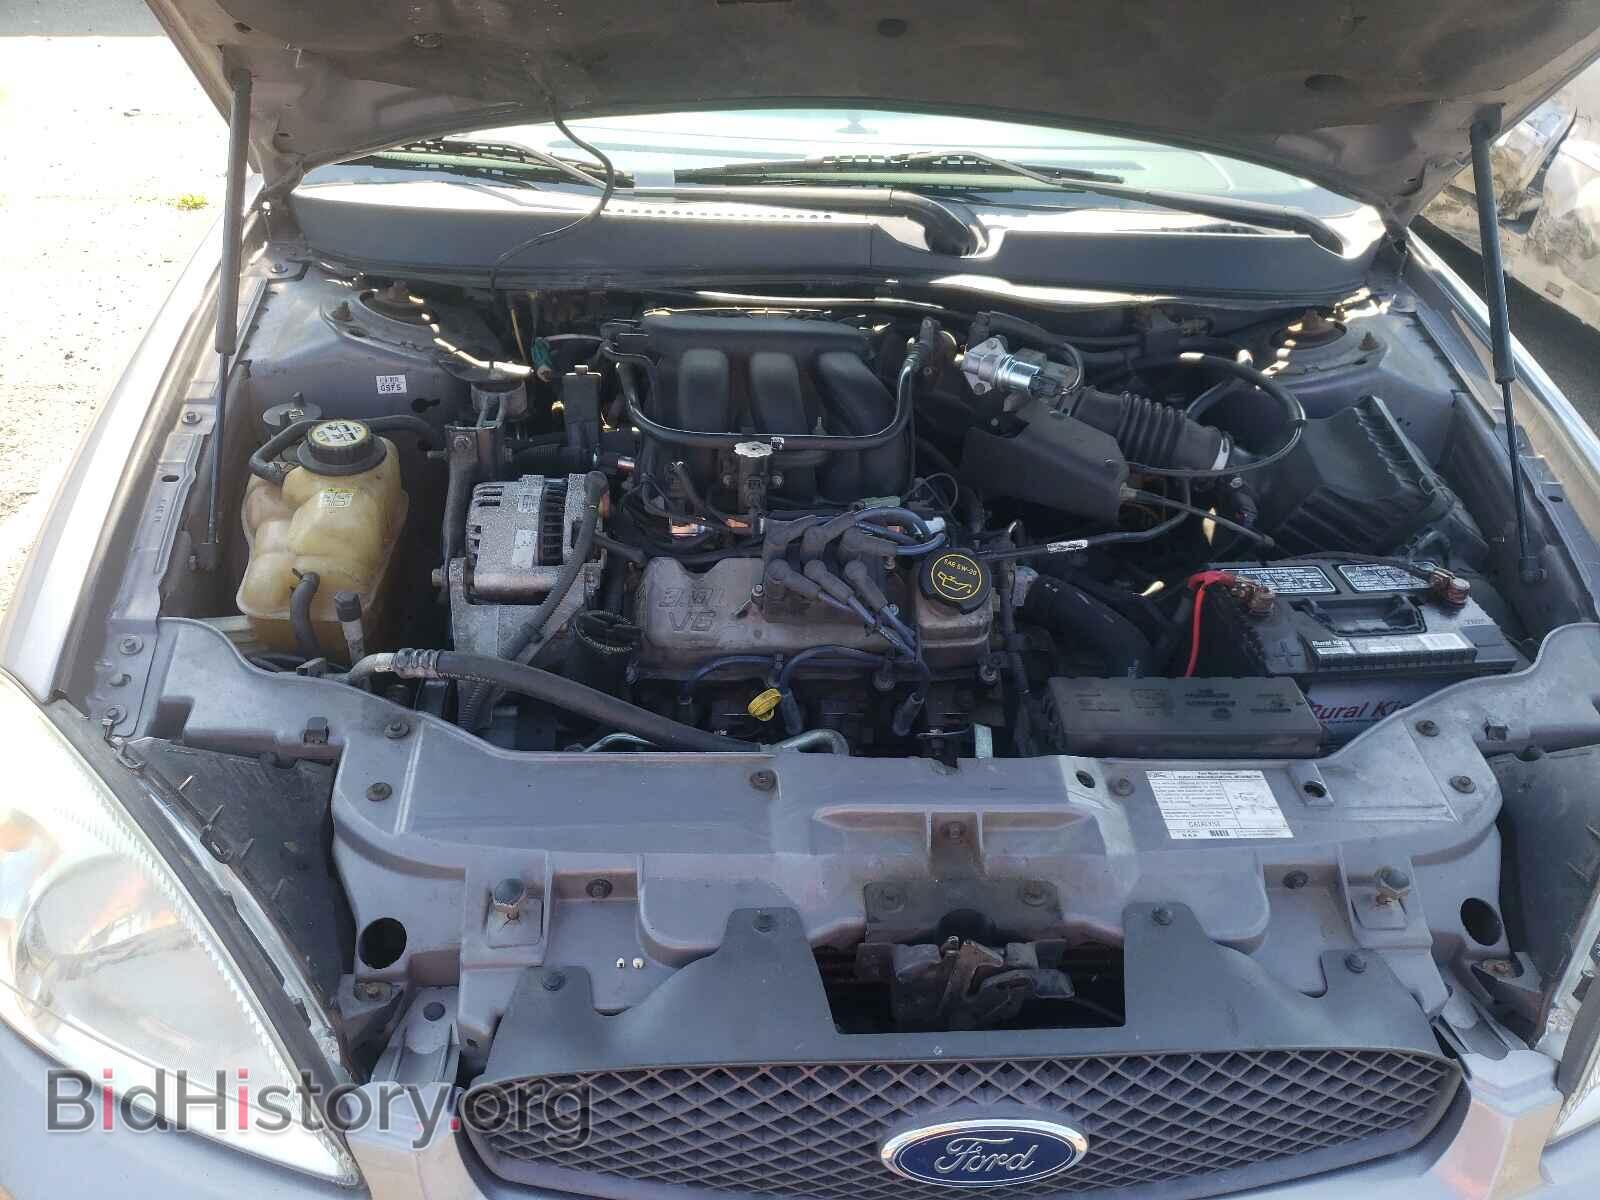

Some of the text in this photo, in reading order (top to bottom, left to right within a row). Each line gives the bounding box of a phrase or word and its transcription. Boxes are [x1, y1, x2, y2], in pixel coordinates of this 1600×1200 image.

[944, 559, 956, 568] SAE
[668, 610, 717, 632] V6
[934, 1137, 1040, 1174] Ford
